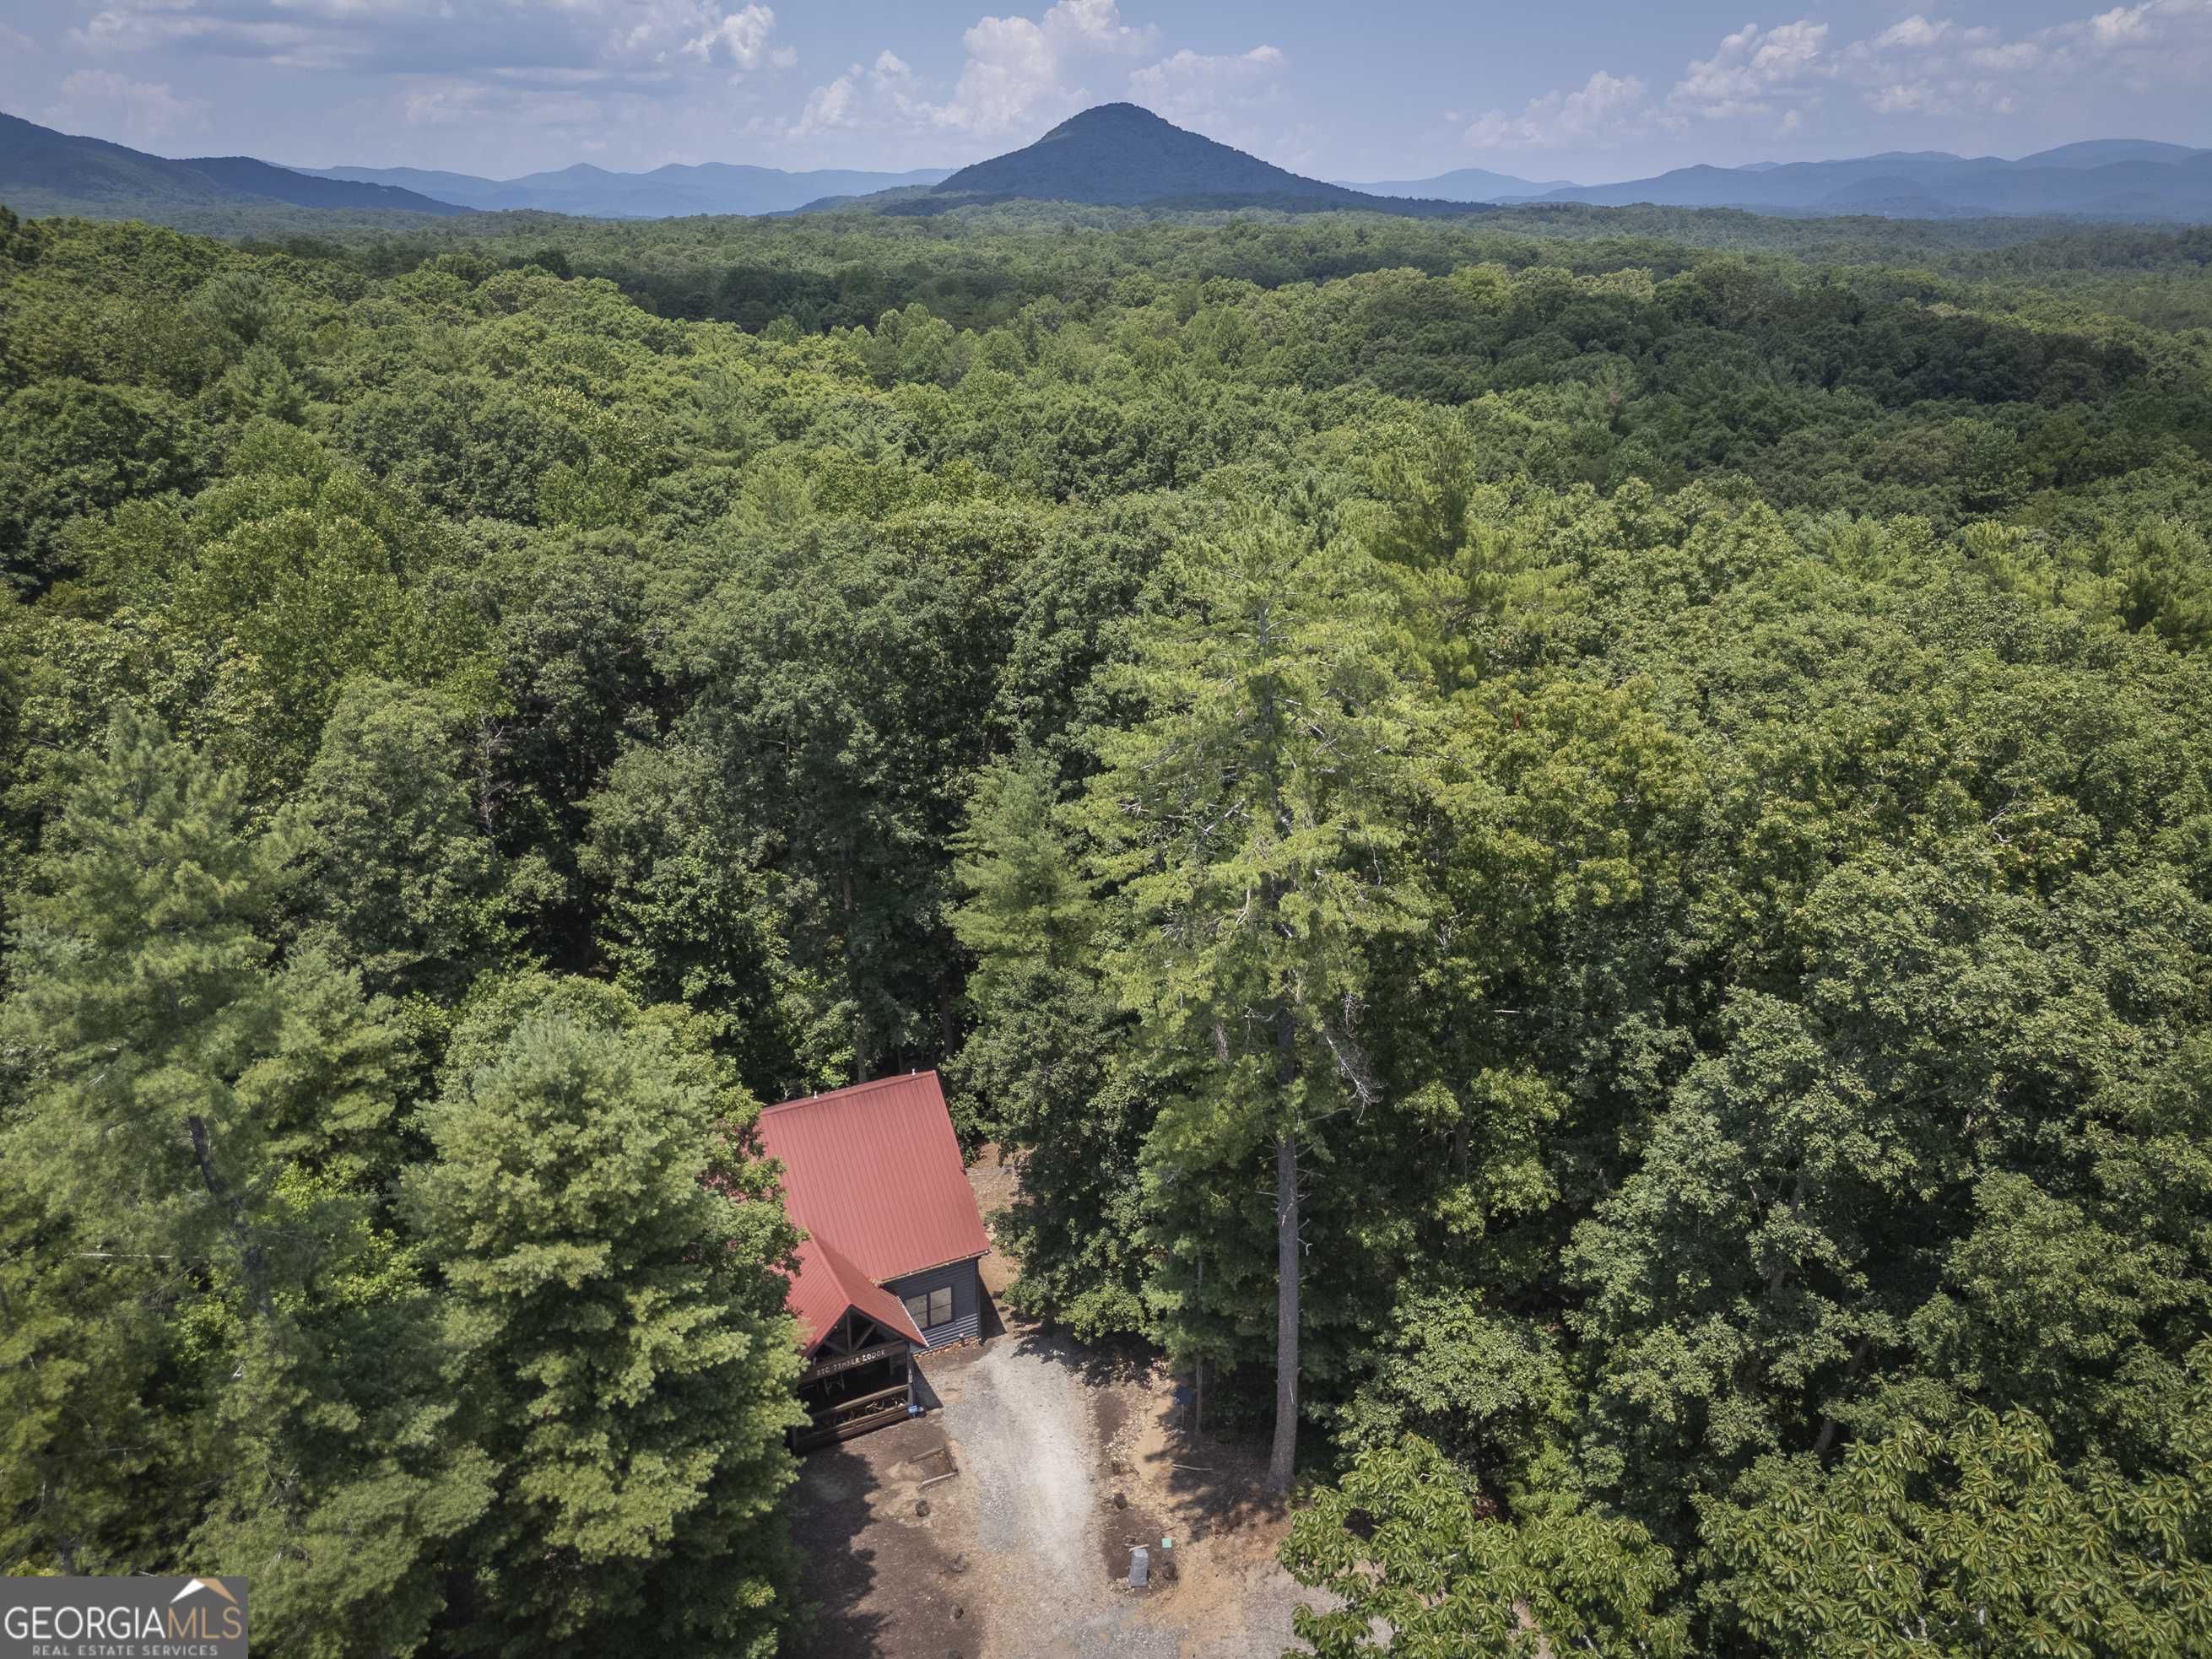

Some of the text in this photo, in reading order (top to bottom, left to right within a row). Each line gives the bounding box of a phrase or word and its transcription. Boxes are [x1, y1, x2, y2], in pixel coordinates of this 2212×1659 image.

[817, 1349, 885, 1376] BIG TIMBER LODGE
